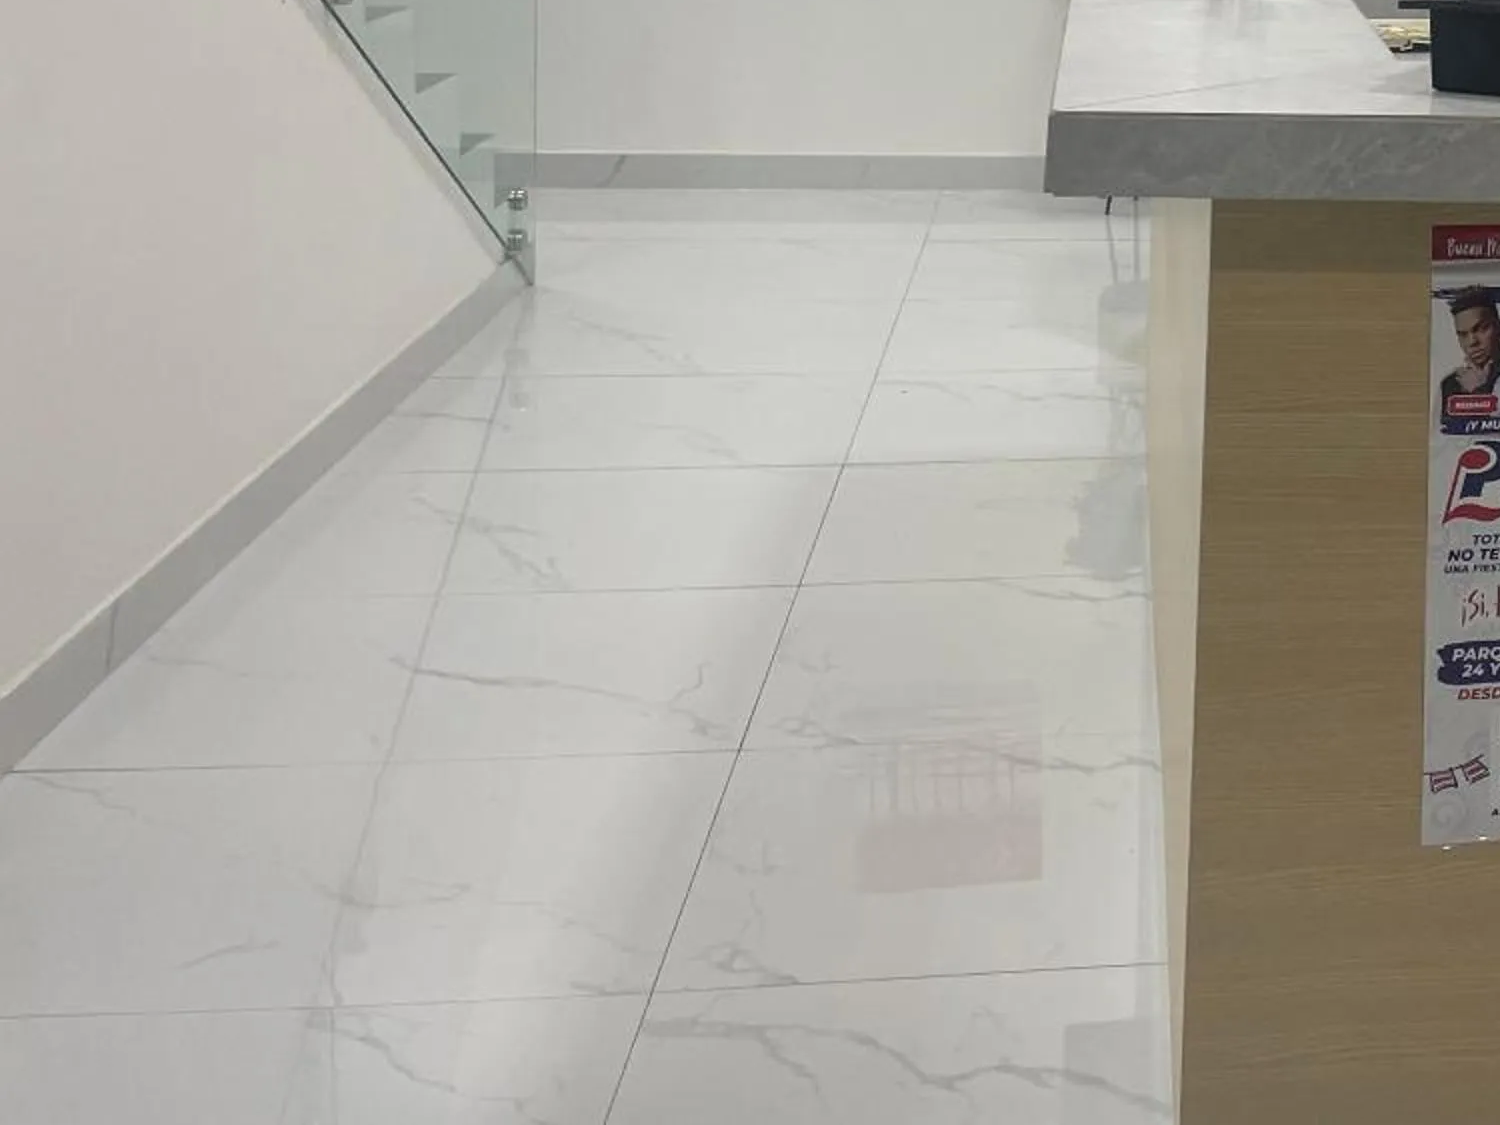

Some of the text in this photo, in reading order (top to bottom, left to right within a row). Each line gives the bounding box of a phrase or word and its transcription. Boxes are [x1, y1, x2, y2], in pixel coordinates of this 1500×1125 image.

[1447, 549, 1475, 562] NO
[1480, 548, 1500, 560] TE
[1444, 565, 1469, 574] UNA
[1462, 663, 1485, 678] 24
